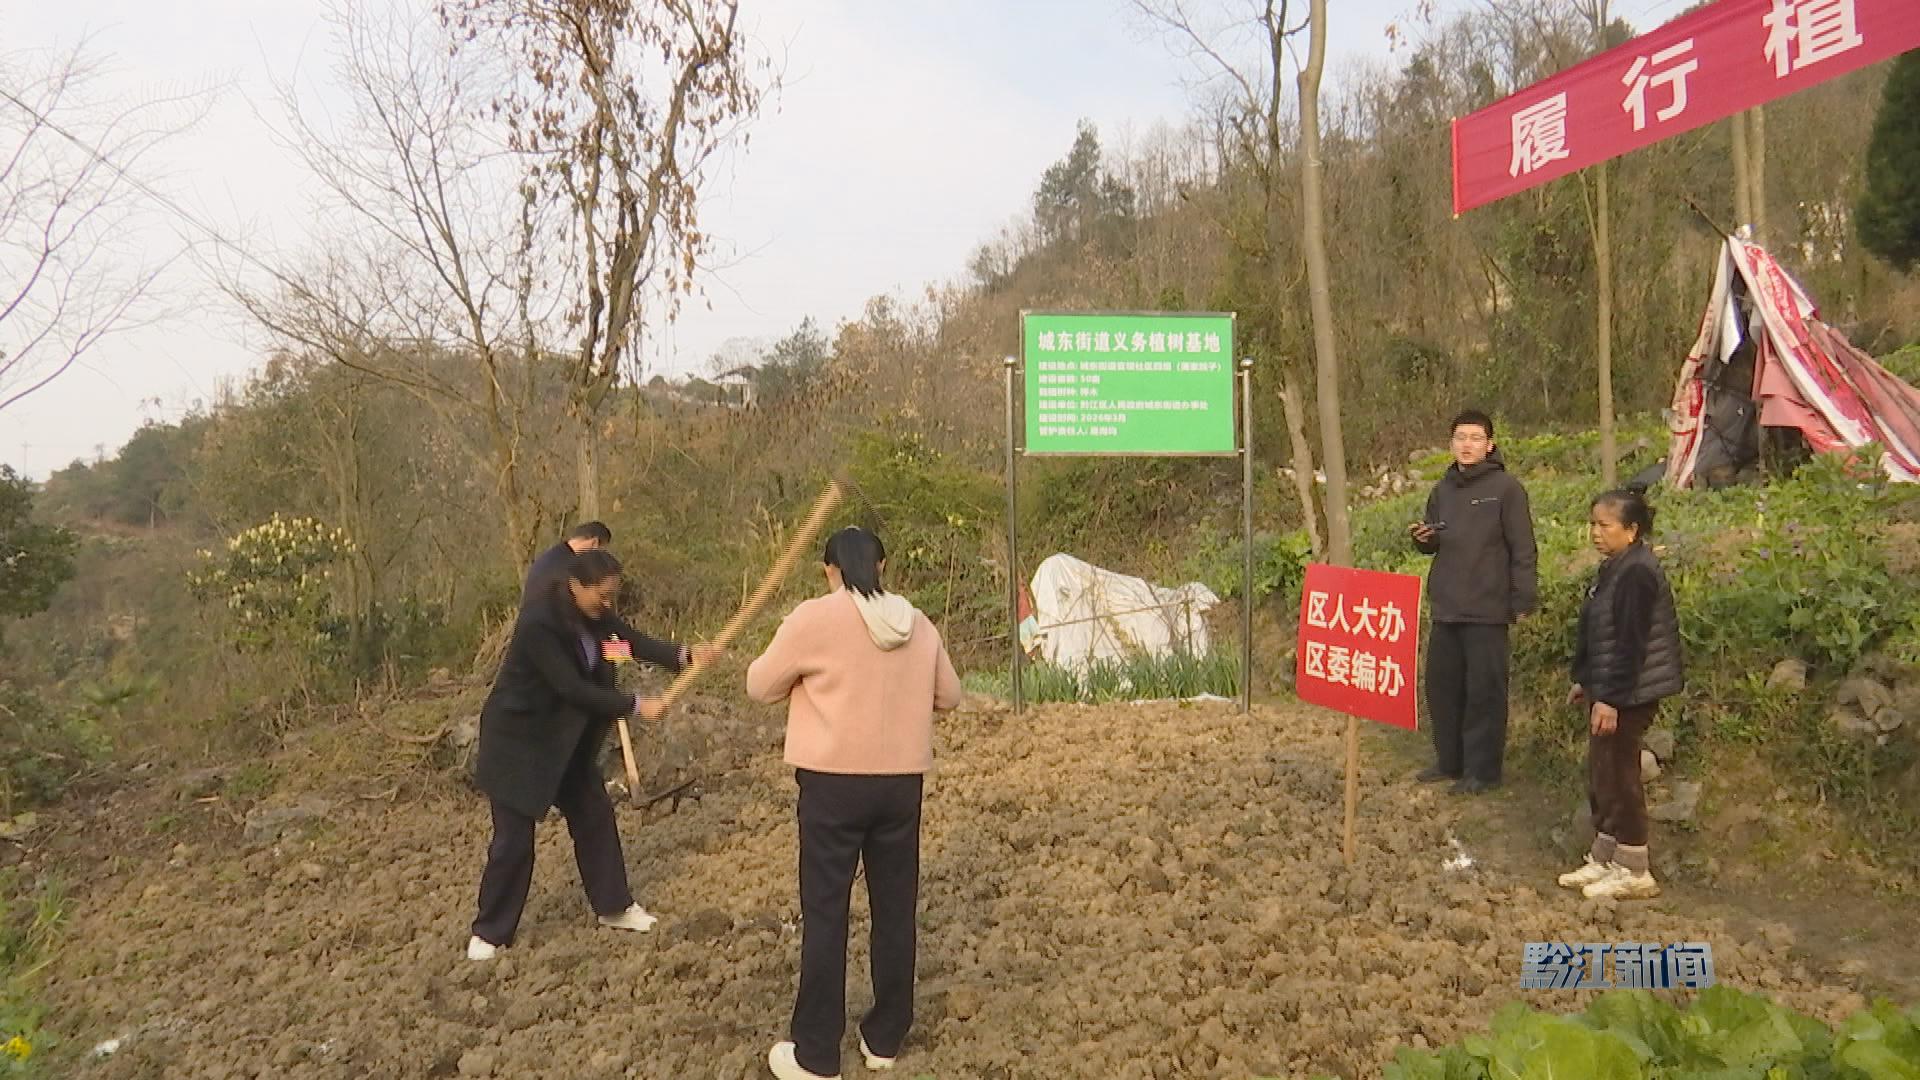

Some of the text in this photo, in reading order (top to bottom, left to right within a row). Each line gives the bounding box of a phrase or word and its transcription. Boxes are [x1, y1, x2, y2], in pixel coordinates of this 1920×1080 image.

[1038, 330, 1221, 352] 城东街道义务植树基地
[1307, 590, 1407, 643] 区人大办
[1305, 640, 1405, 698] 区委编办
